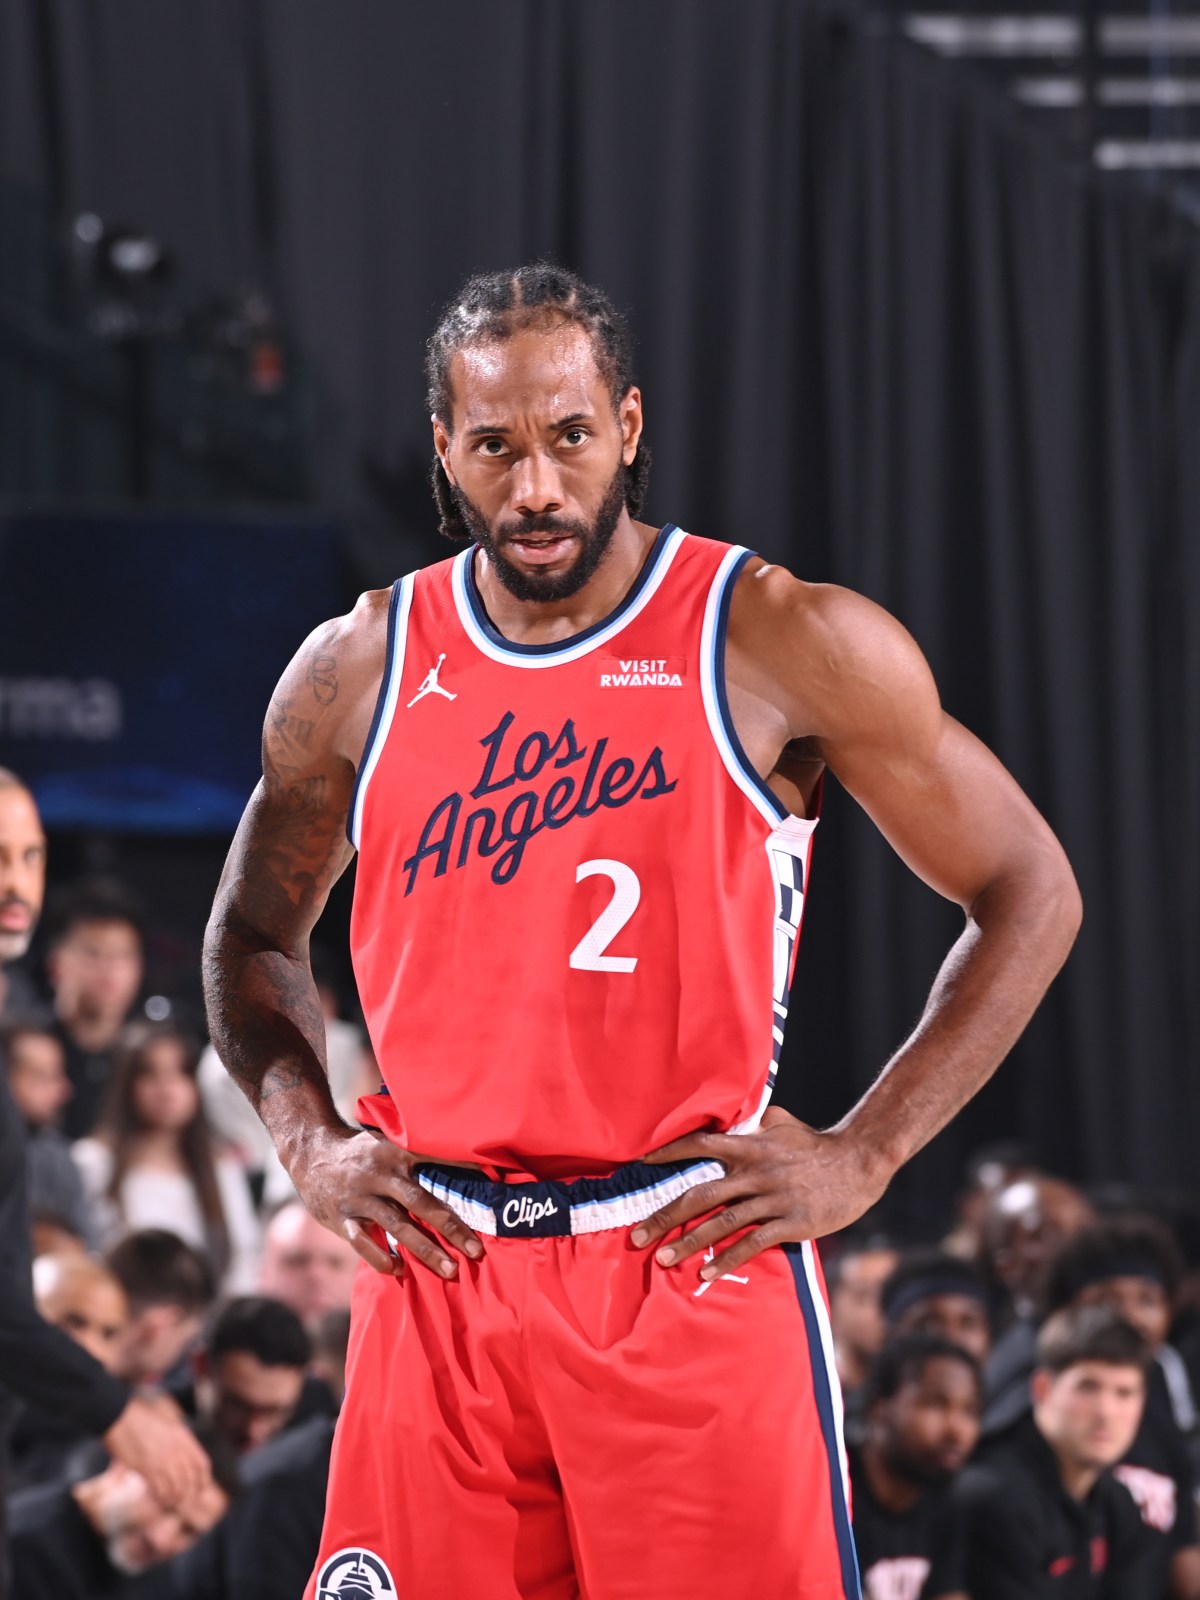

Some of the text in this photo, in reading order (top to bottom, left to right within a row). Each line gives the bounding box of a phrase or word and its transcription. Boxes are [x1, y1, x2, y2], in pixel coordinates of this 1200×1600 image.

[600, 673, 683, 687] RWANDA
[619, 659, 667, 673] VISIT
[469, 710, 587, 799] Los
[402, 737, 678, 897] Angeles
[569, 859, 641, 973] 2
[502, 1196, 558, 1228] Clips
